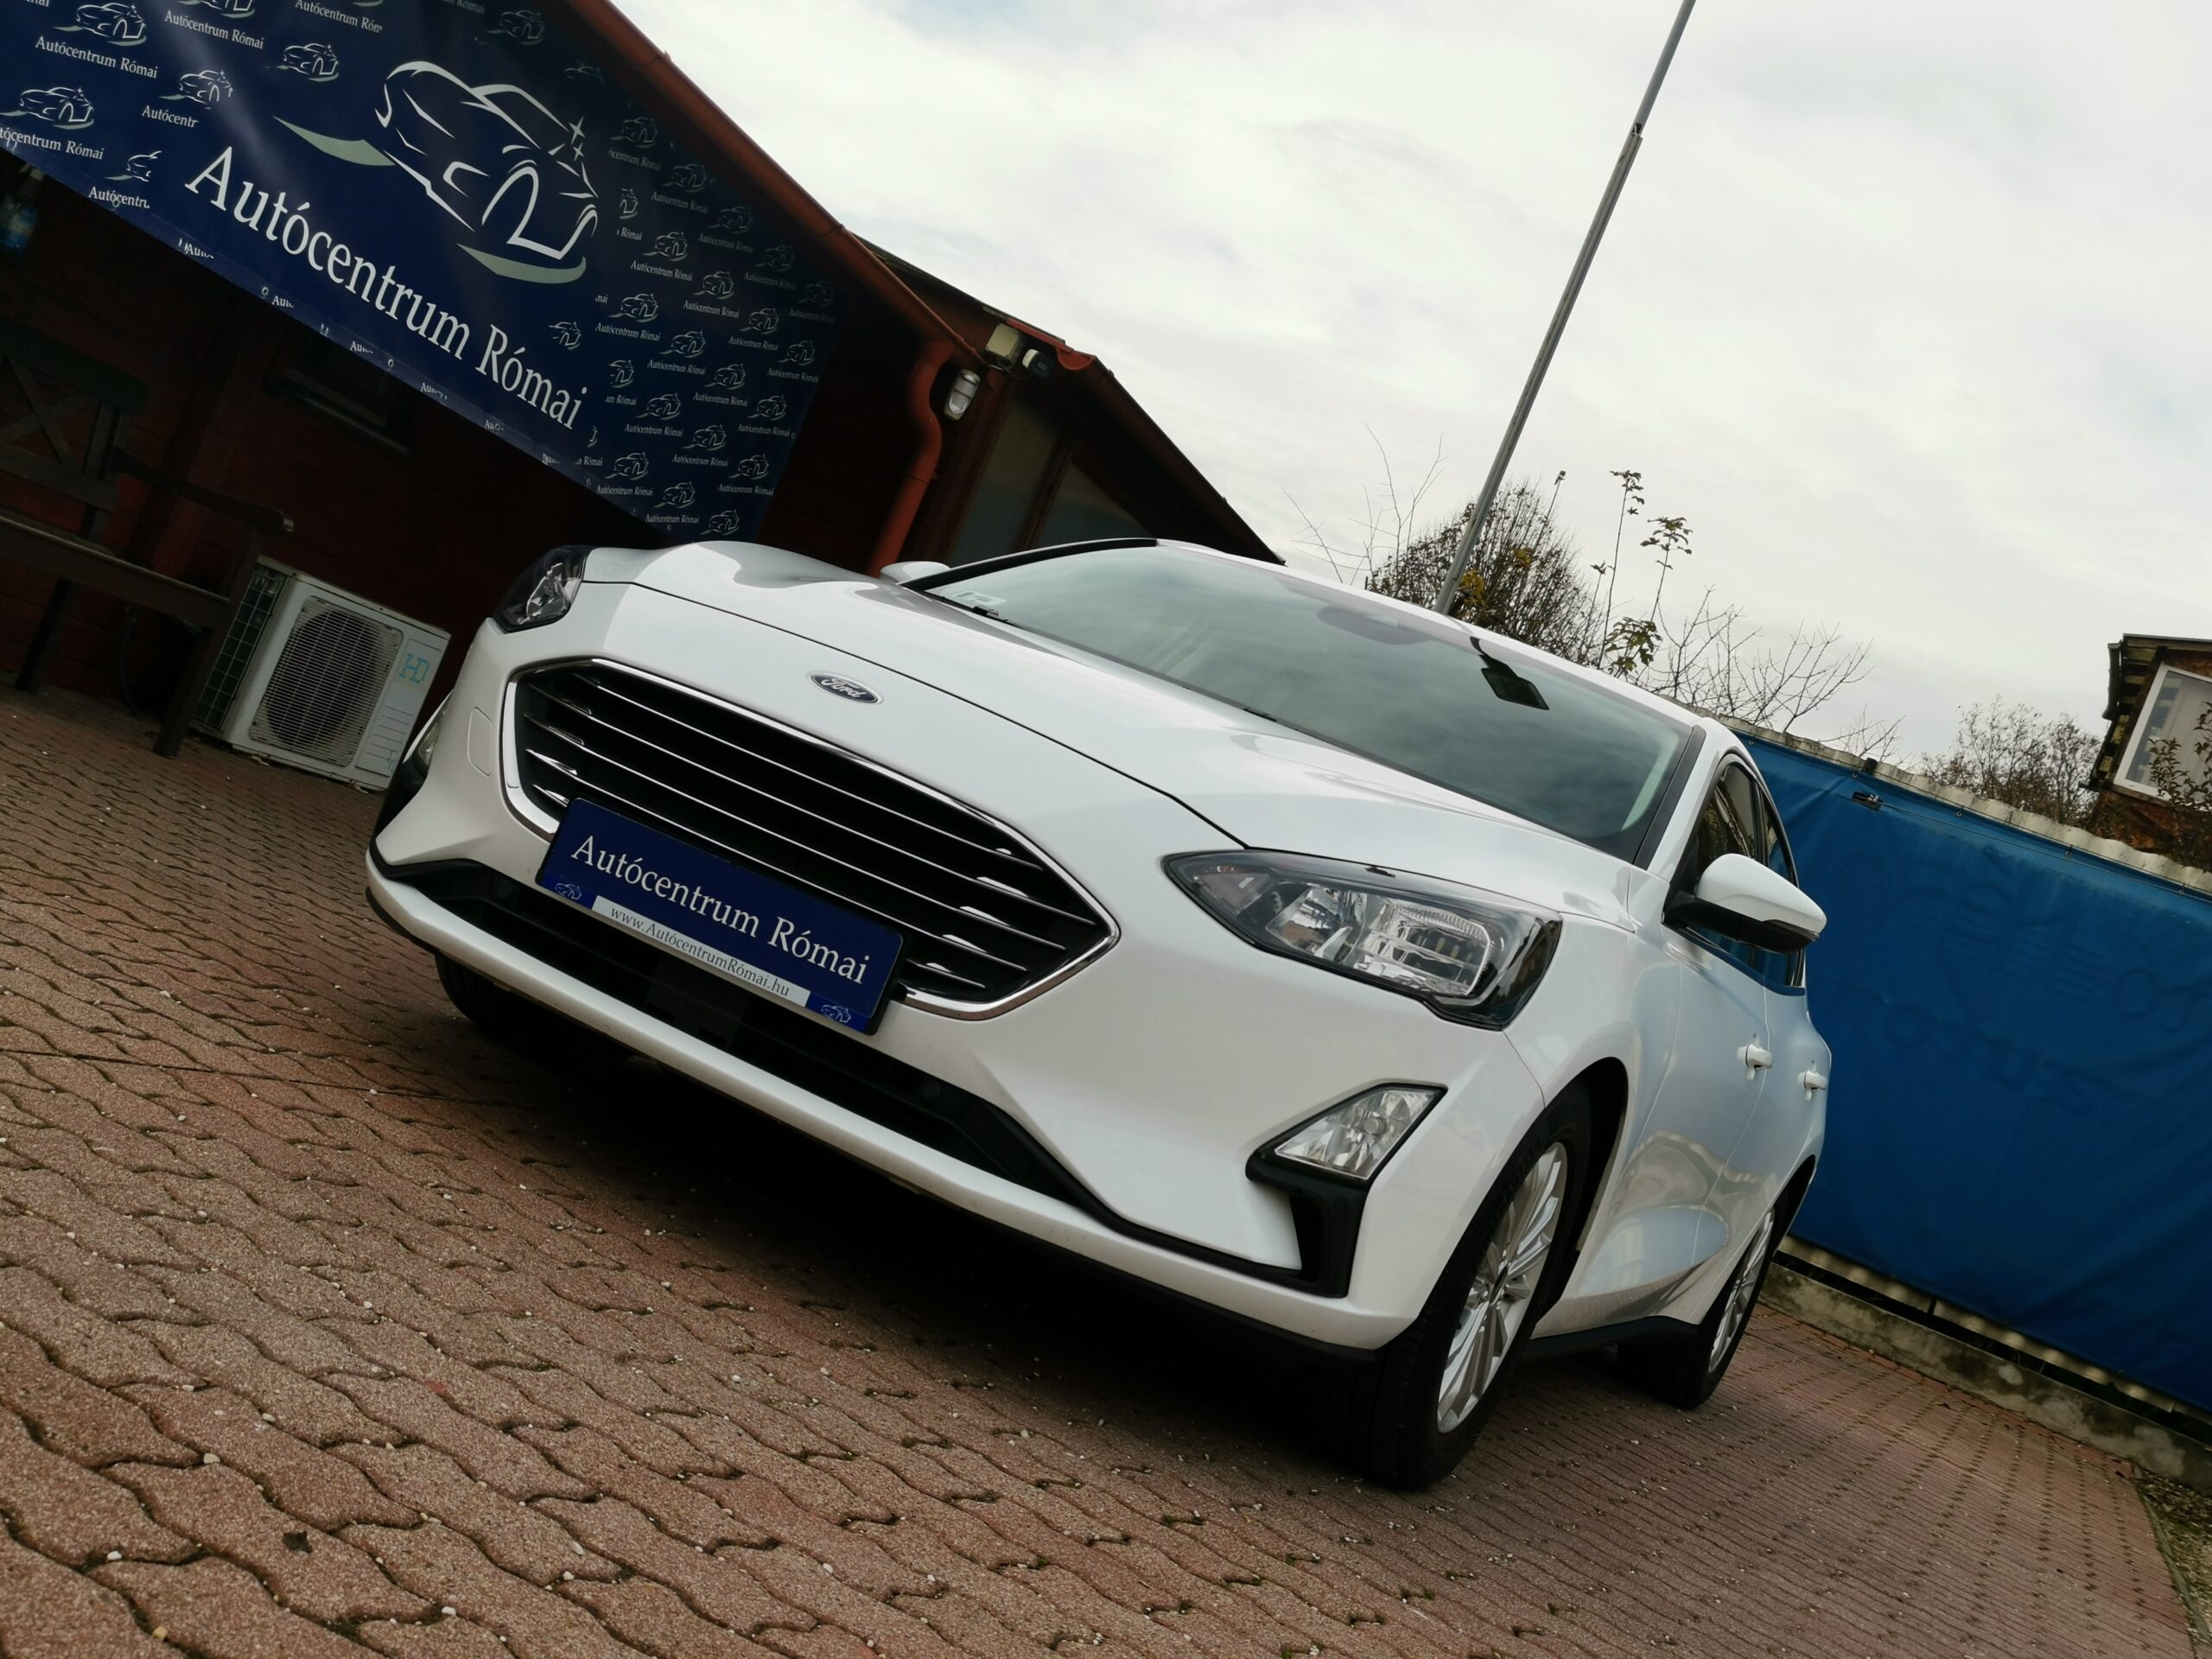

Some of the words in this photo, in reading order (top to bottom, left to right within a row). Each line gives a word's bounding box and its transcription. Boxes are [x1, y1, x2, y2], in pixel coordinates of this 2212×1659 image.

[164, 10, 229, 40] Autócentrum
[232, 29, 265, 50] Római
[295, 0, 358, 27] Autócentrum
[35, 35, 117, 68] Autócentrum
[120, 57, 159, 79] Római
[65, 140, 105, 161] Római
[185, 146, 472, 361] Autócentrum
[474, 324, 588, 430] Római
[594, 322, 639, 338] Autócentrum
[821, 677, 867, 697] Ford
[570, 834, 761, 938] Autócentrum
[766, 916, 870, 985] Római
[610, 907, 791, 998] www.AutócentrumRómai.hu
